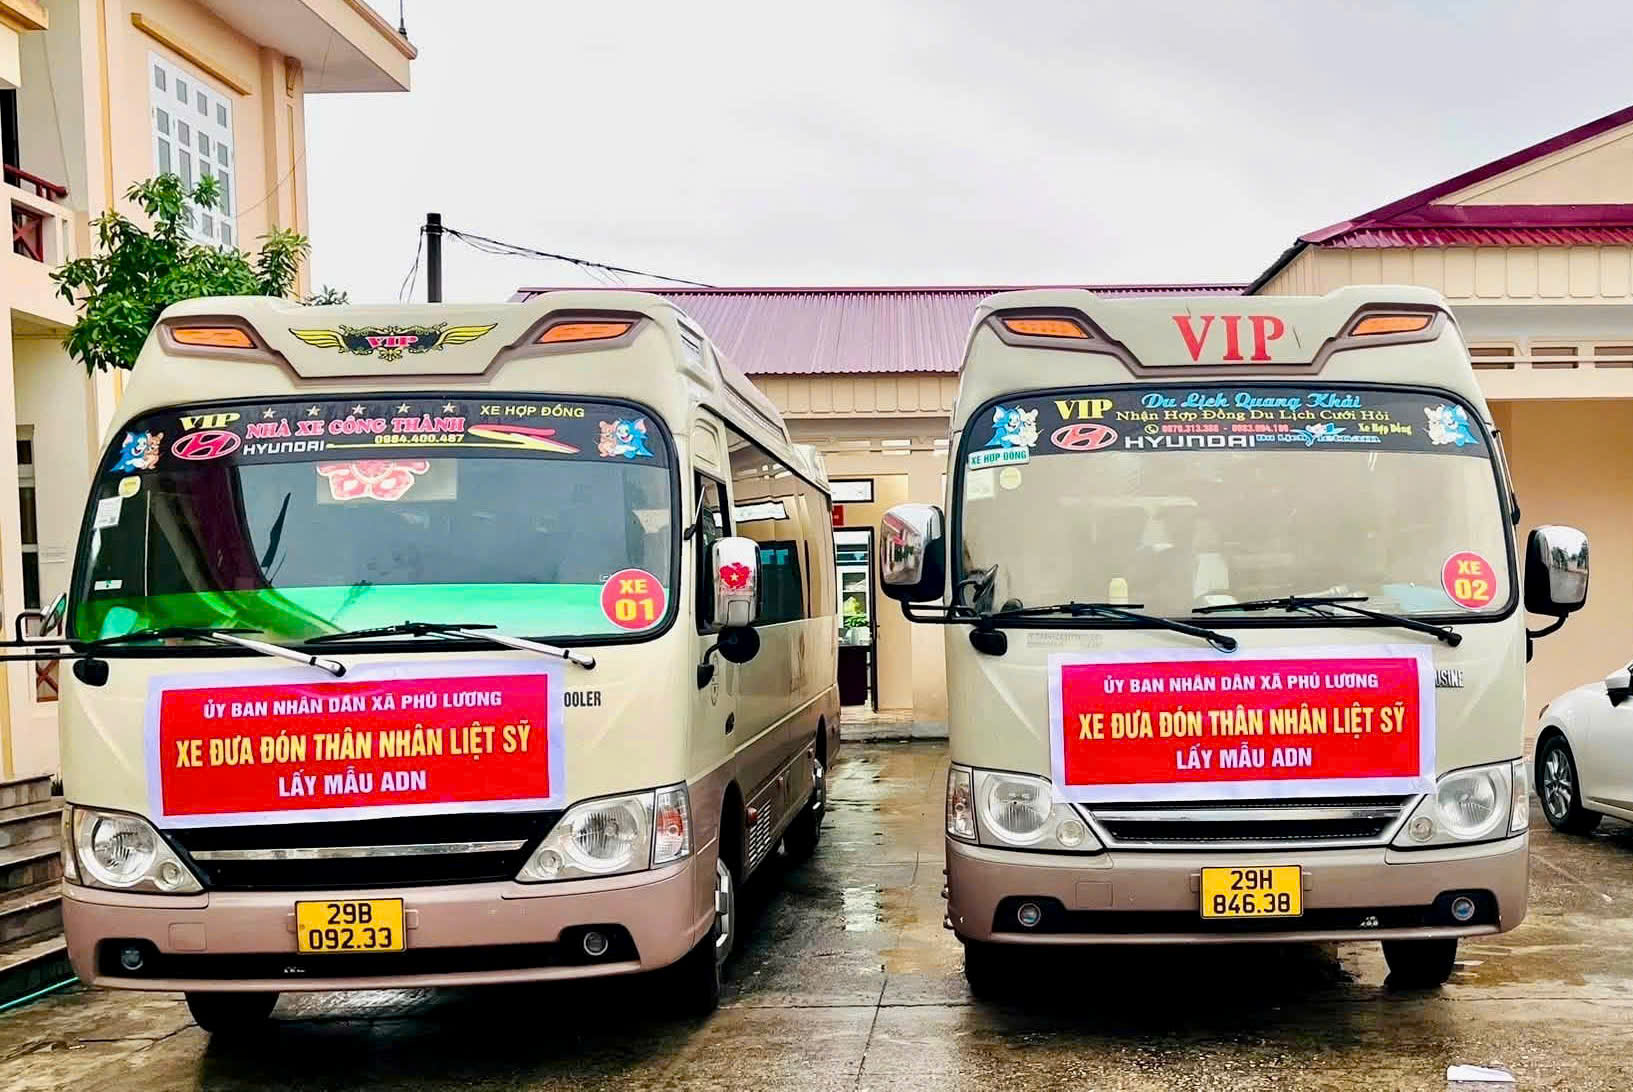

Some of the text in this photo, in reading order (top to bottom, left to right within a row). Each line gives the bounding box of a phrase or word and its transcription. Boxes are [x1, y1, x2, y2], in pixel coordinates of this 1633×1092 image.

[365, 336, 418, 348] VIP
[1172, 315, 1285, 361] VIP
[480, 403, 585, 418] XE HỢP ĐỒNG
[1054, 399, 1113, 420] VIP
[1141, 393, 1177, 408] Du
[1180, 392, 1230, 410] Lịch
[1234, 392, 1302, 410] Quang
[179, 413, 241, 431] VIP
[1116, 408, 1390, 422] Nhận Hợp Đồng Du Lịch Cưới Hỏi
[295, 420, 325, 436] XE
[328, 416, 388, 435] CÔNG
[243, 440, 325, 456] HYUNDAI
[1125, 435, 1255, 448] HYUNDAI
[970, 455, 981, 465] XE
[1456, 560, 1483, 575] XE
[619, 579, 649, 594] XE
[1455, 579, 1489, 600] 02
[615, 598, 655, 621] 01
[1103, 671, 1379, 693] ỦY BAN NHÂN DÂN XÃ PHÚ LƯƠNG
[1435, 669, 1465, 688] USINE
[203, 691, 502, 719] ỦY BAN NHÂN DÂN XÃ PHÚ LƯƠNG
[563, 691, 601, 708] OOLER
[1079, 701, 1405, 740] XE ĐƯA ĐÓN THÂN NHÂN LIỆT SỸ
[176, 719, 531, 768] XE ĐƯA ĐÓN THÂN NHÂN LIỆT SỸ
[1176, 742, 1312, 770] LẤY MẪU ADN
[278, 765, 427, 797] LẤY MẪU ADN
[1231, 869, 1273, 890] 29H
[327, 903, 372, 925] 29B
[1213, 893, 1290, 914] 846.38
[309, 927, 392, 949] 092.33
